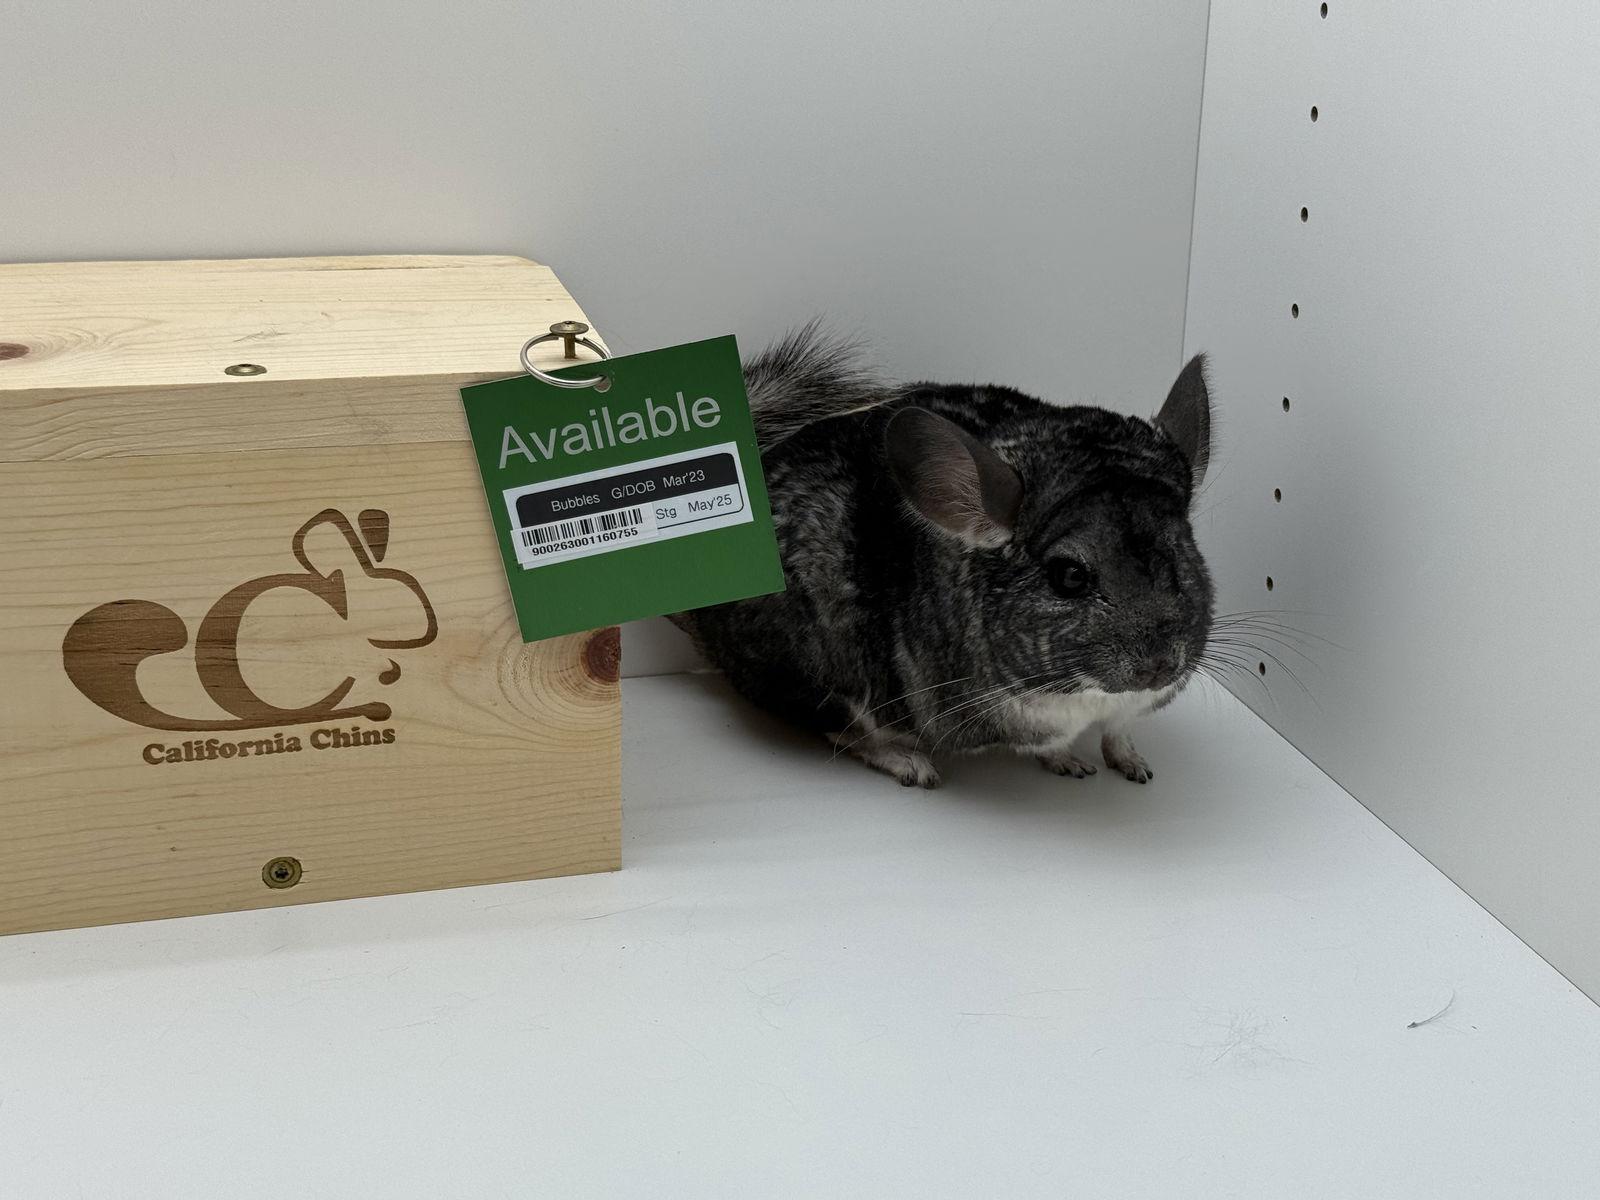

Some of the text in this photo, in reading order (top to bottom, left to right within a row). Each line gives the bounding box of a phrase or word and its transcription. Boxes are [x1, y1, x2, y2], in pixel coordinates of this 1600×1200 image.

[498, 391, 721, 470] Available
[551, 470, 706, 512] Bubbles G/DOB Mar'23
[655, 494, 733, 520] Stg May'25
[531, 527, 639, 557] 900263001160755
[142, 726, 396, 765] California Chins
